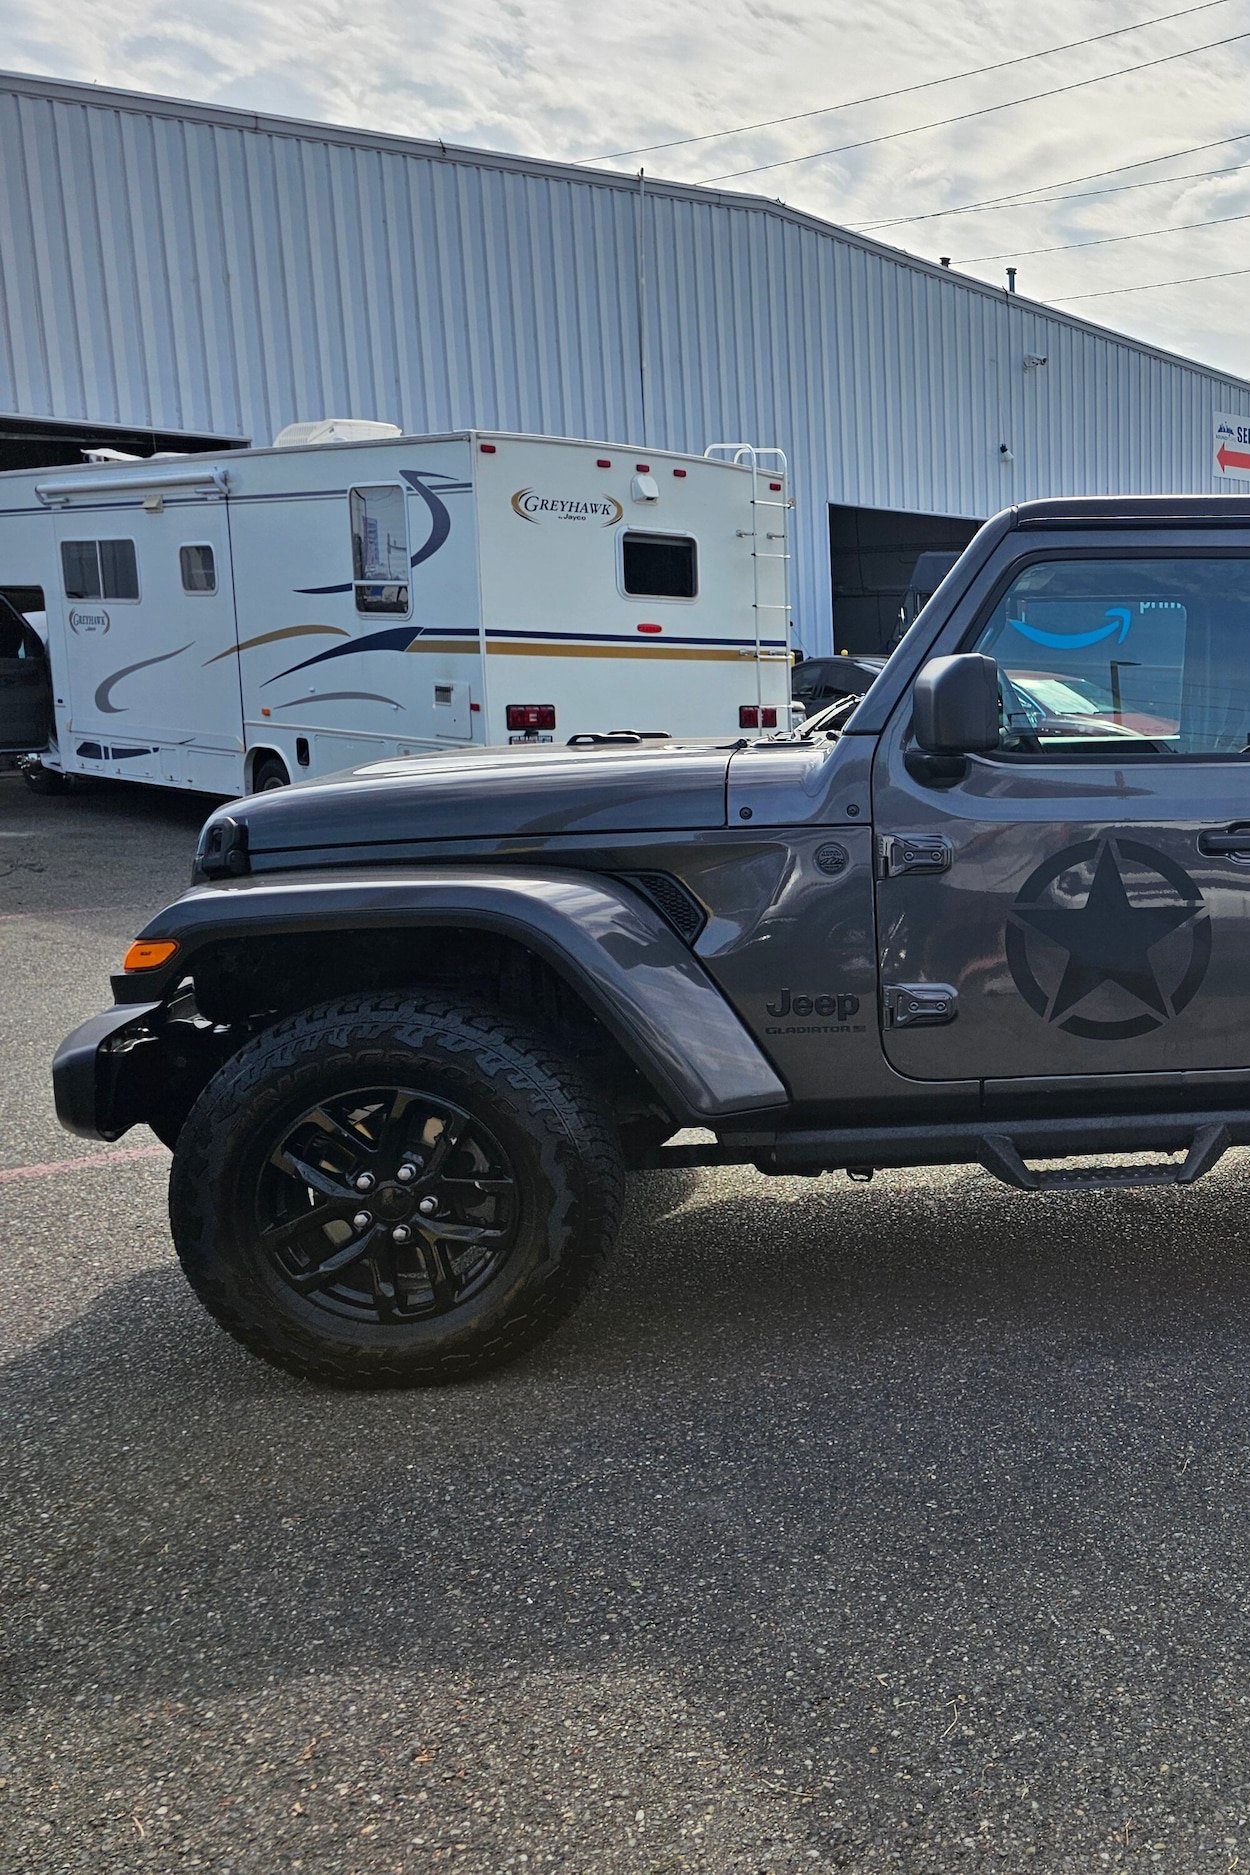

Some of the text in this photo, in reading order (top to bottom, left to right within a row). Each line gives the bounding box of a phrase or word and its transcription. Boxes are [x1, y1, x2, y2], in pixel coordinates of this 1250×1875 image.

[523, 496, 612, 515] GREYHAWK
[563, 513, 587, 521] Jayco
[766, 987, 860, 1021] Jeep
[765, 1026, 850, 1035] GLADIATOR
